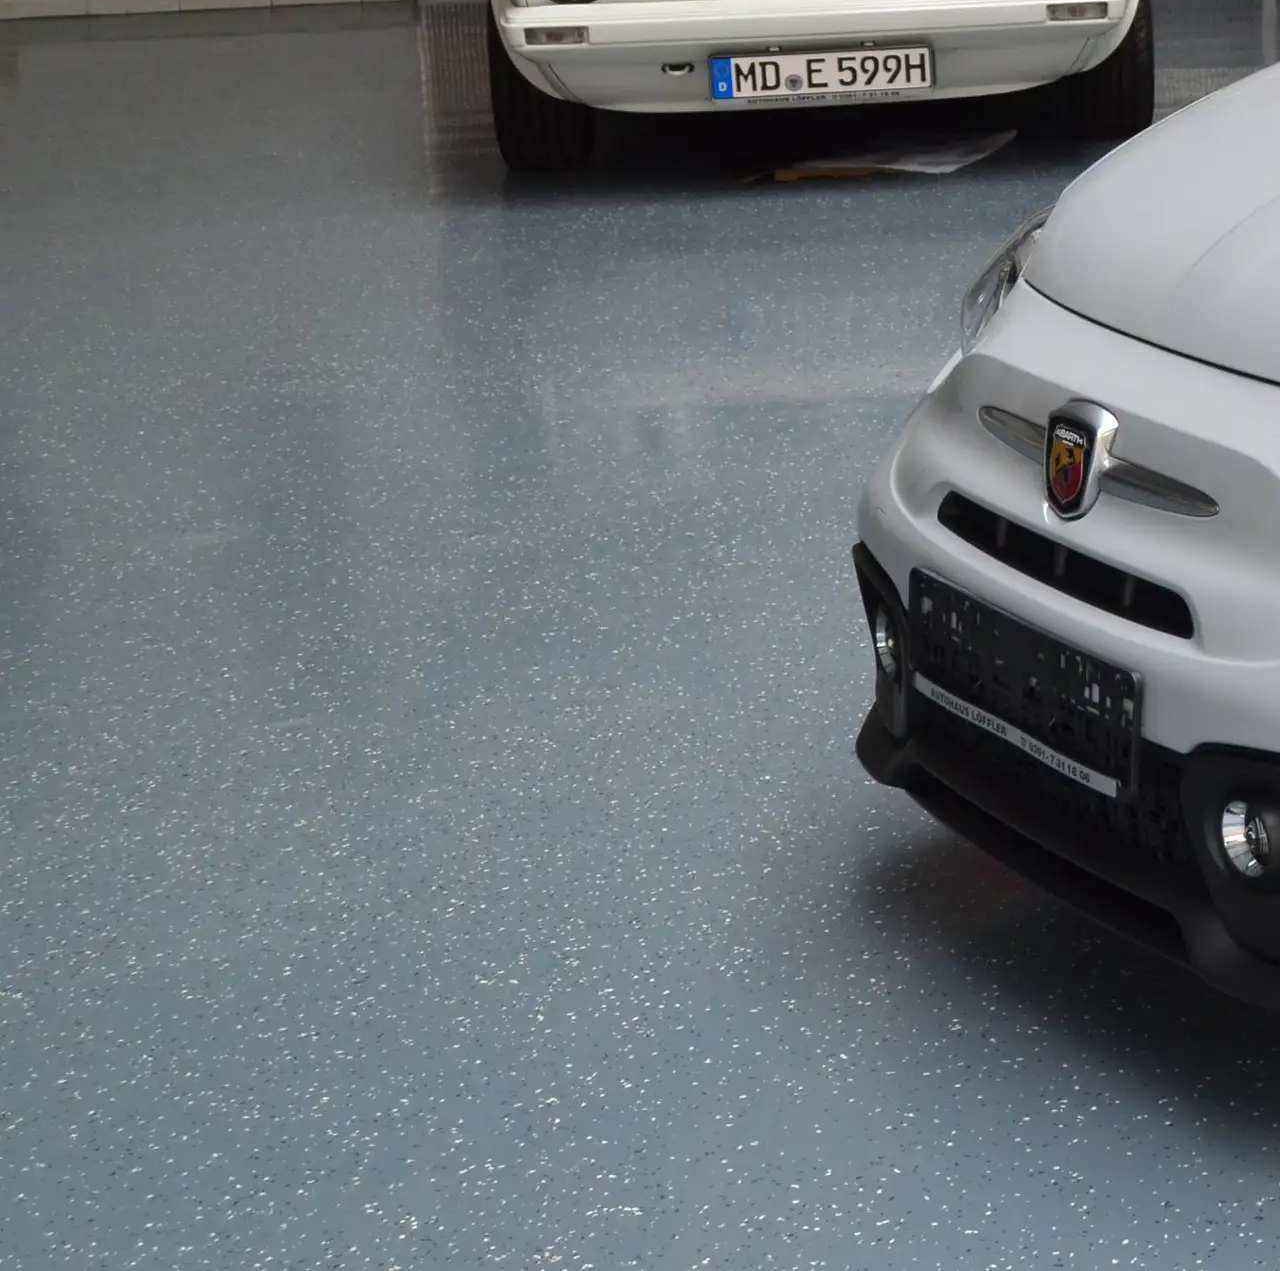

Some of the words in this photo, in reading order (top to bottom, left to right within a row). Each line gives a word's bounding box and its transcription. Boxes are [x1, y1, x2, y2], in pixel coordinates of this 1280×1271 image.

[734, 61, 781, 92] MD
[806, 58, 829, 89] E
[837, 53, 927, 87] 599H
[718, 82, 727, 92] D
[1055, 427, 1084, 445] ABARTH
[931, 687, 969, 716] AUTOHAUS
[972, 709, 1006, 737] LÖFFLER
